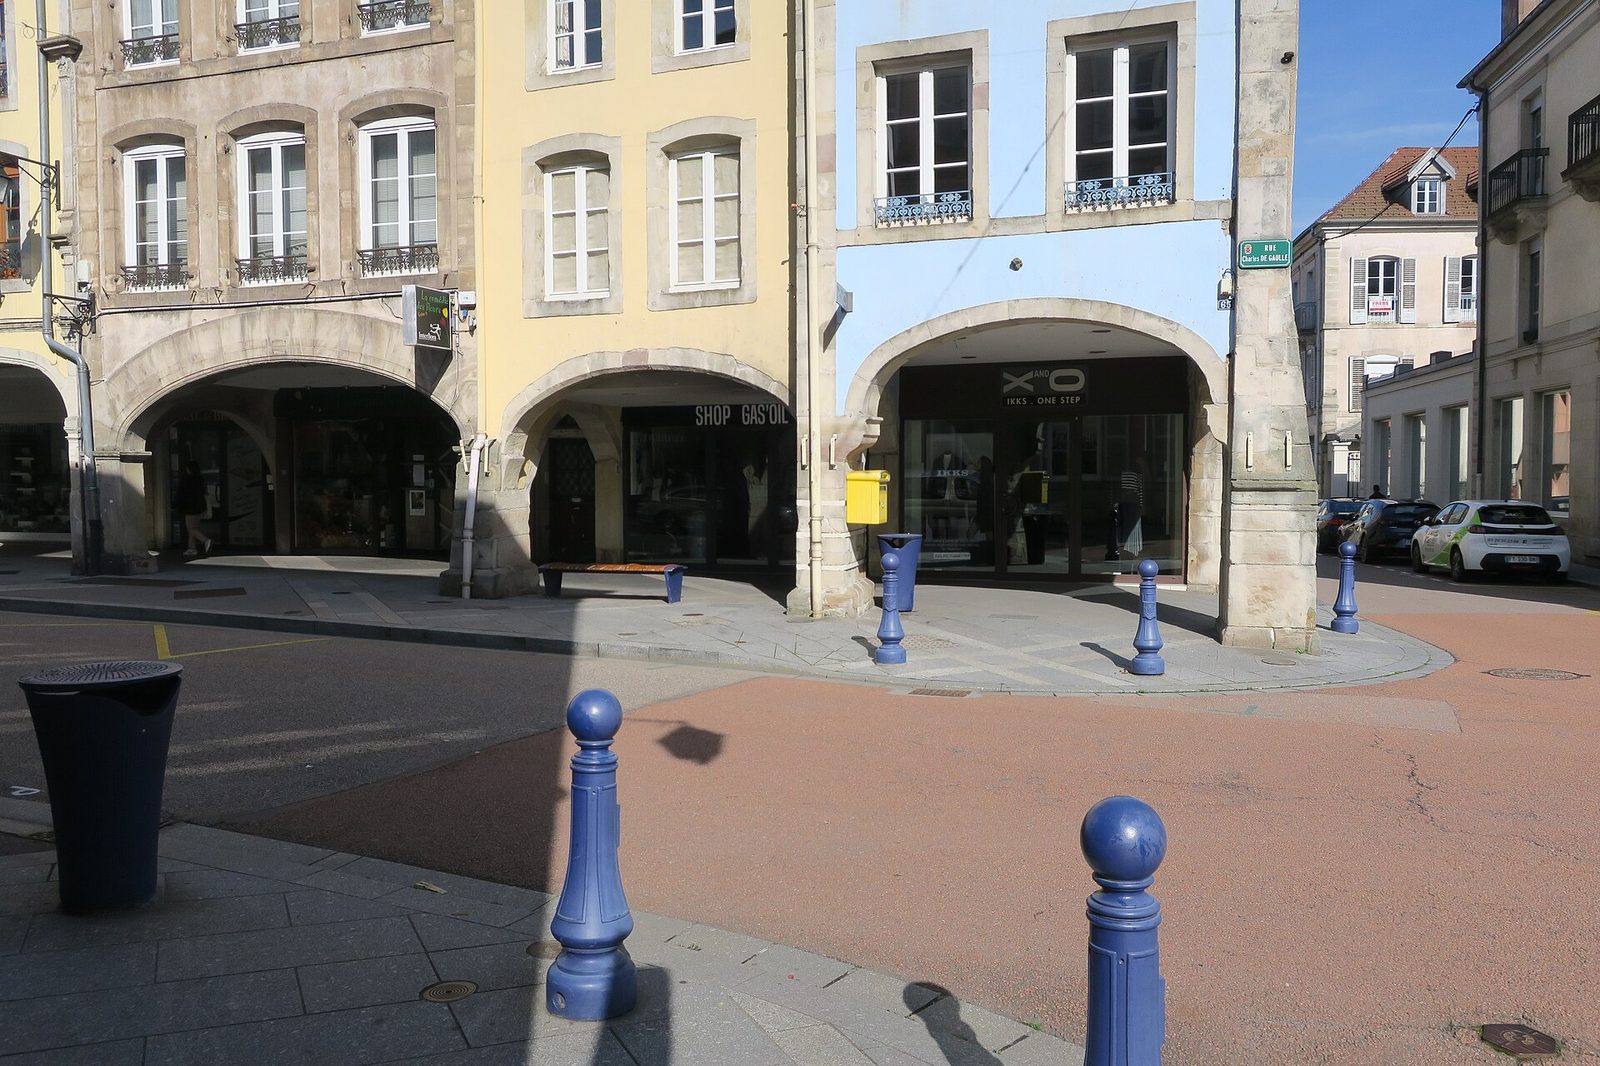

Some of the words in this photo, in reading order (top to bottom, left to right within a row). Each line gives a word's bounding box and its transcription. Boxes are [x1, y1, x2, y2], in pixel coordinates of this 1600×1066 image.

[1003, 370, 1034, 393] X
[1034, 370, 1050, 378] AND
[1049, 368, 1086, 392] O
[1060, 396, 1081, 404] STEP
[695, 405, 731, 426] SHOP
[741, 404, 789, 425] GAS'OIL
[936, 469, 969, 477] IKKS
